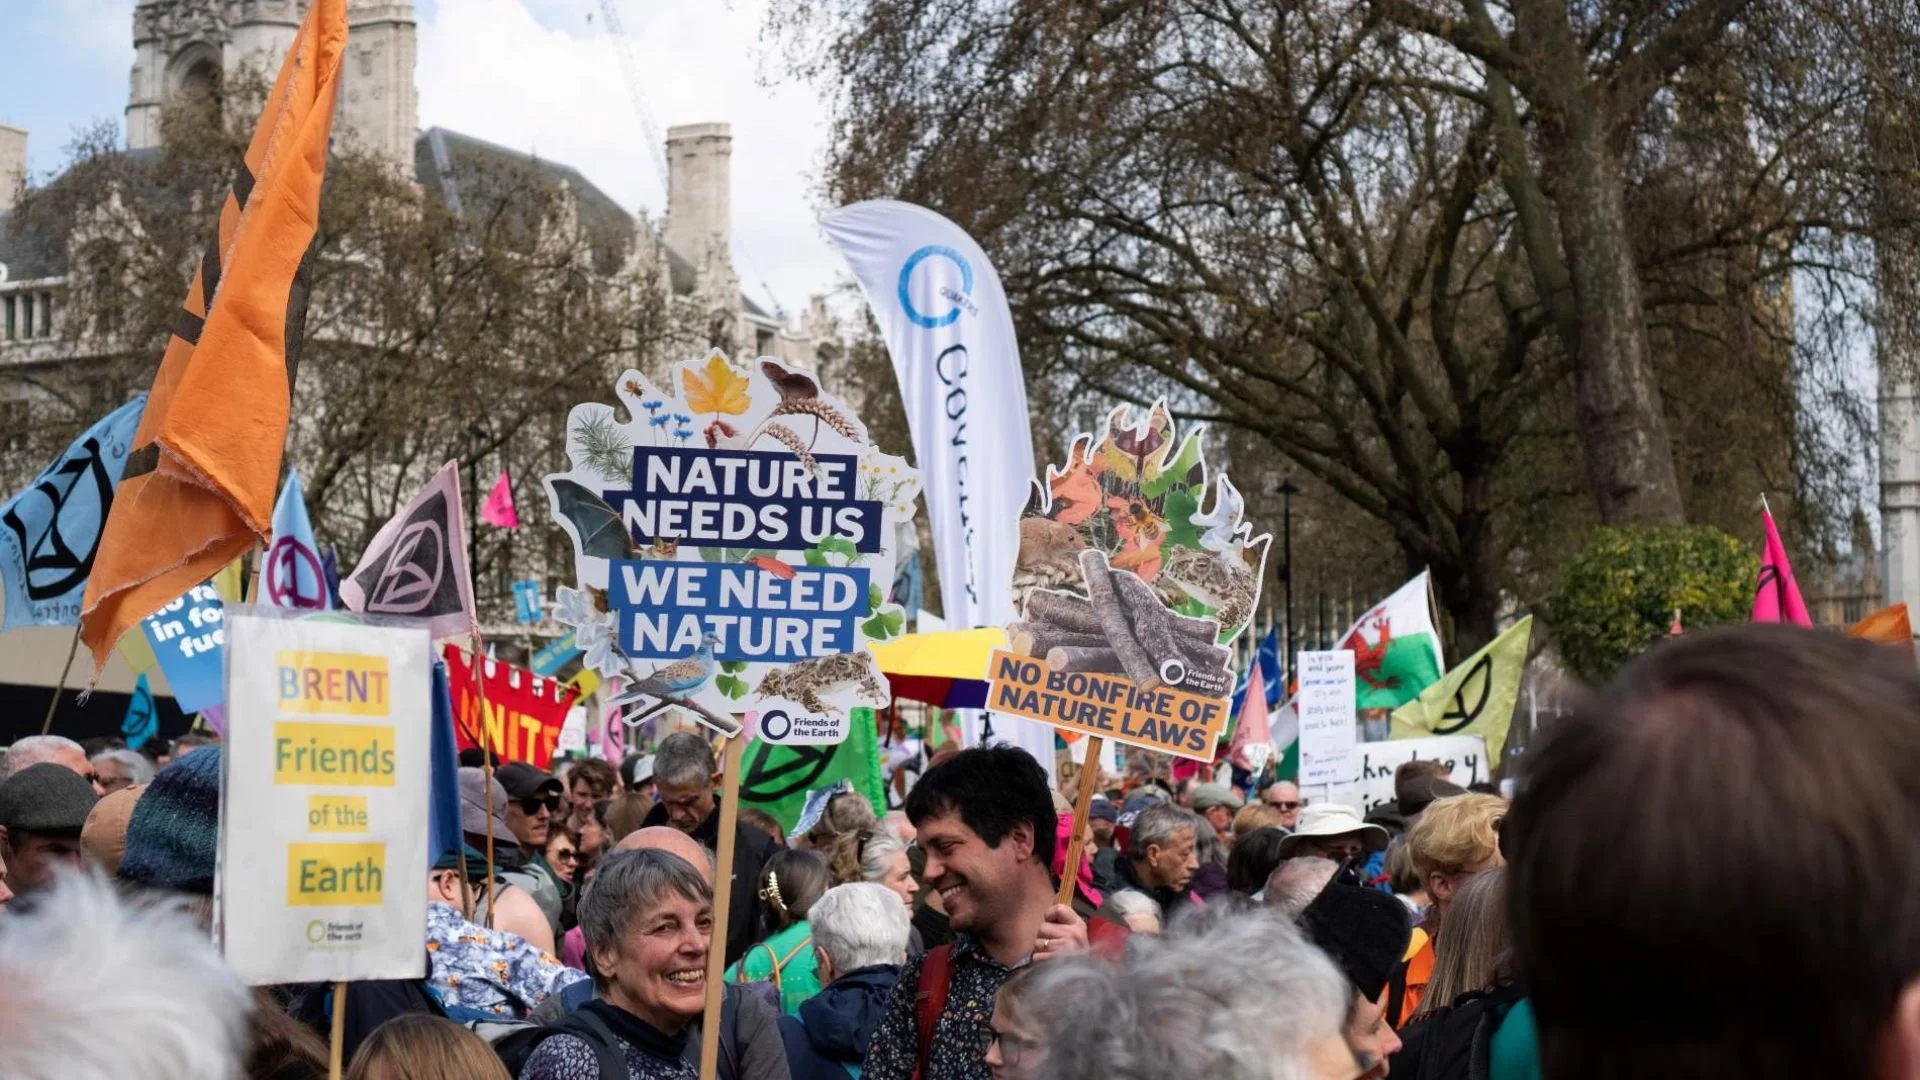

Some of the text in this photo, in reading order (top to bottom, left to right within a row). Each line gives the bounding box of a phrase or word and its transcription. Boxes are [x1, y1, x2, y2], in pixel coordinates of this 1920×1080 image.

[646, 455, 846, 500] NATURE
[623, 499, 865, 543] NEEDS US
[621, 565, 858, 612] WE NEED
[150, 620, 185, 643] in
[632, 612, 842, 657] NATURE
[279, 666, 388, 704] BRENT
[999, 657, 1221, 726] NO BONFIRE OF
[1186, 678, 1224, 692] the Earth
[1187, 669, 1216, 680] Friends
[794, 718, 840, 727] Friends of
[794, 728, 839, 737] the Earth
[999, 684, 1117, 731] NATURE
[1120, 712, 1208, 752] LAWS
[275, 738, 395, 775] Friends
[309, 804, 368, 826] of the
[299, 857, 383, 893] Earth
